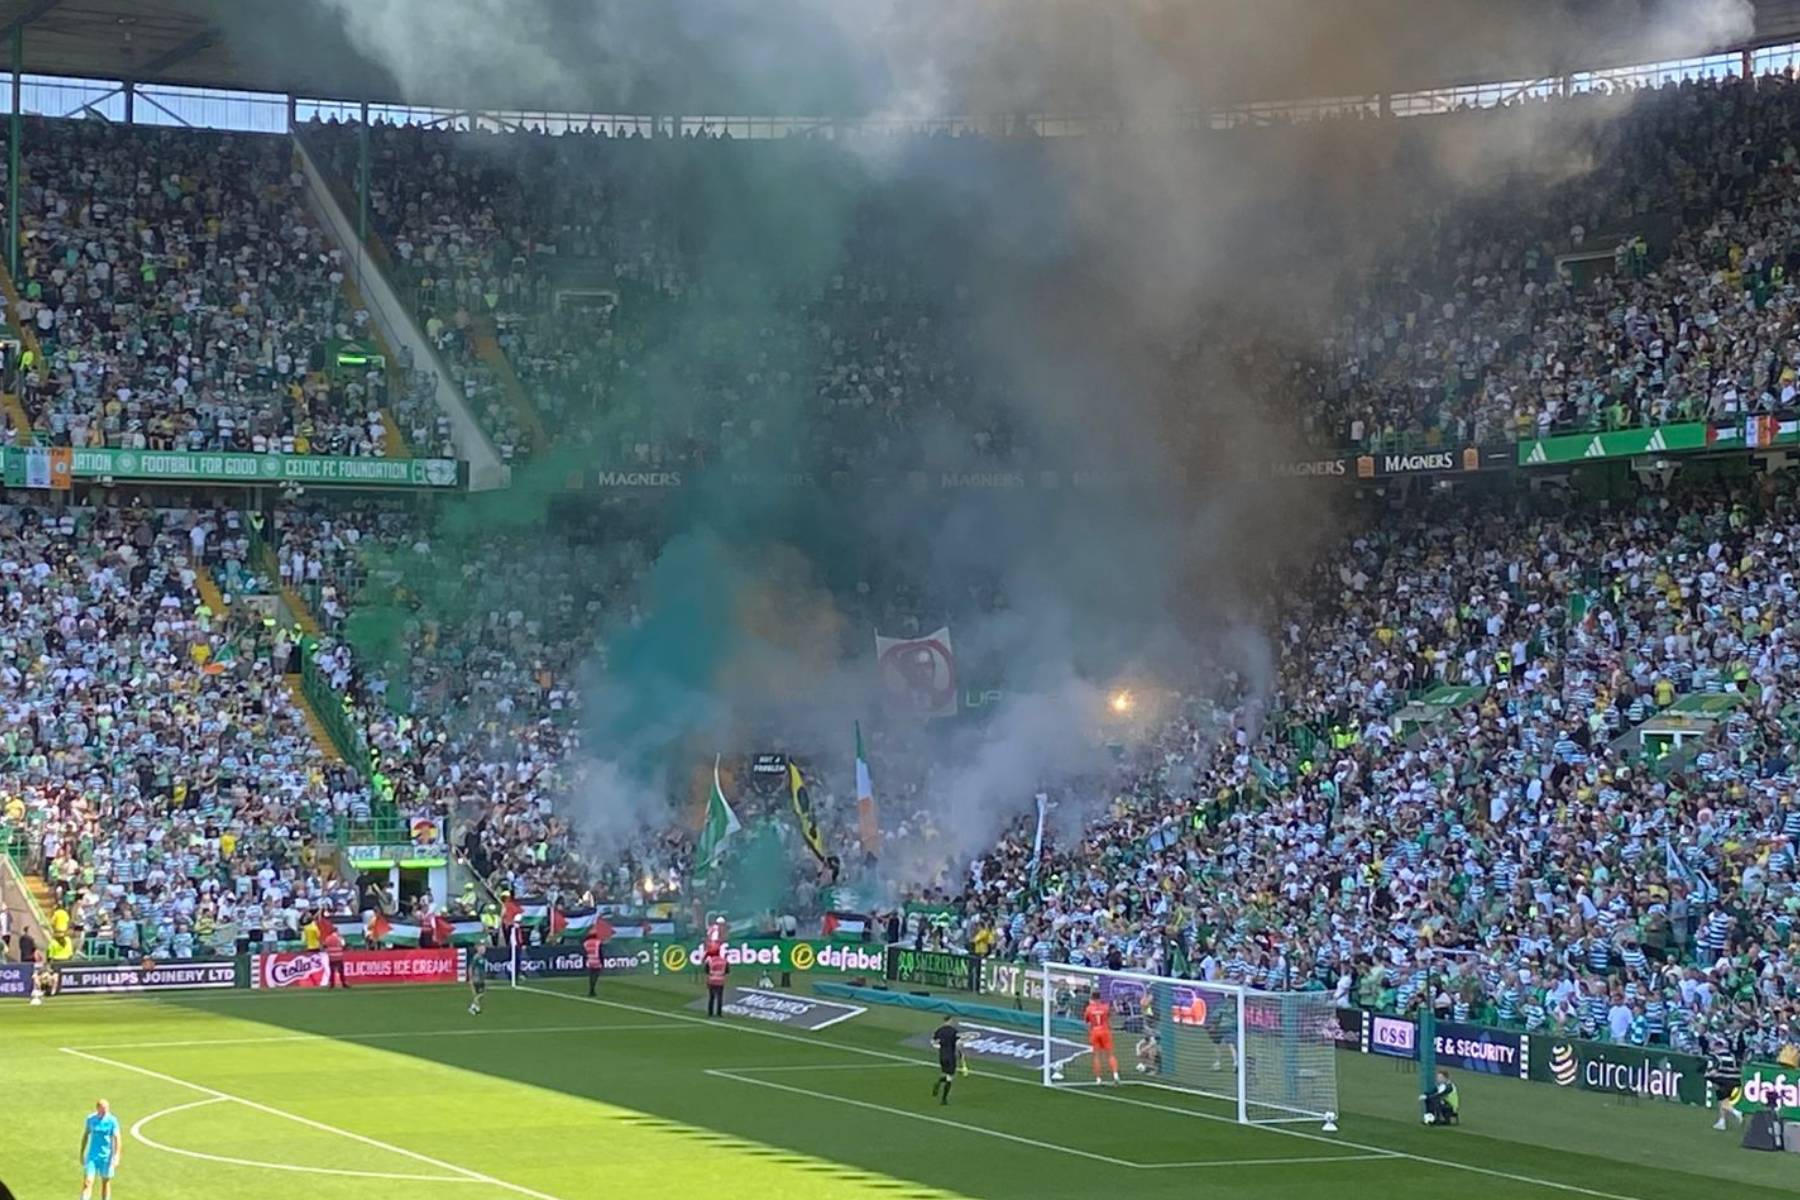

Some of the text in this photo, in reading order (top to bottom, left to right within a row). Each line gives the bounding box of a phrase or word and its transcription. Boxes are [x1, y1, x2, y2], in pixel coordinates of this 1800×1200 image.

[141, 455, 257, 475] FOOTBALL FOR GOOD
[285, 460, 408, 478] CELTIC FC FOUNDATION
[1383, 452, 1452, 472] MAGNERS
[599, 471, 681, 486] MAGNERS
[556, 955, 583, 970] find
[816, 944, 883, 972] dafabet
[61, 976, 79, 986] M.
[143, 970, 204, 983] JOINERY
[208, 969, 235, 980] LTD
[987, 964, 1019, 994] JST
[1380, 1027, 1407, 1045] CSS
[1445, 1038, 1455, 1055] &
[1457, 1038, 1515, 1064] SECURITY
[1586, 1055, 1684, 1097] circulair
